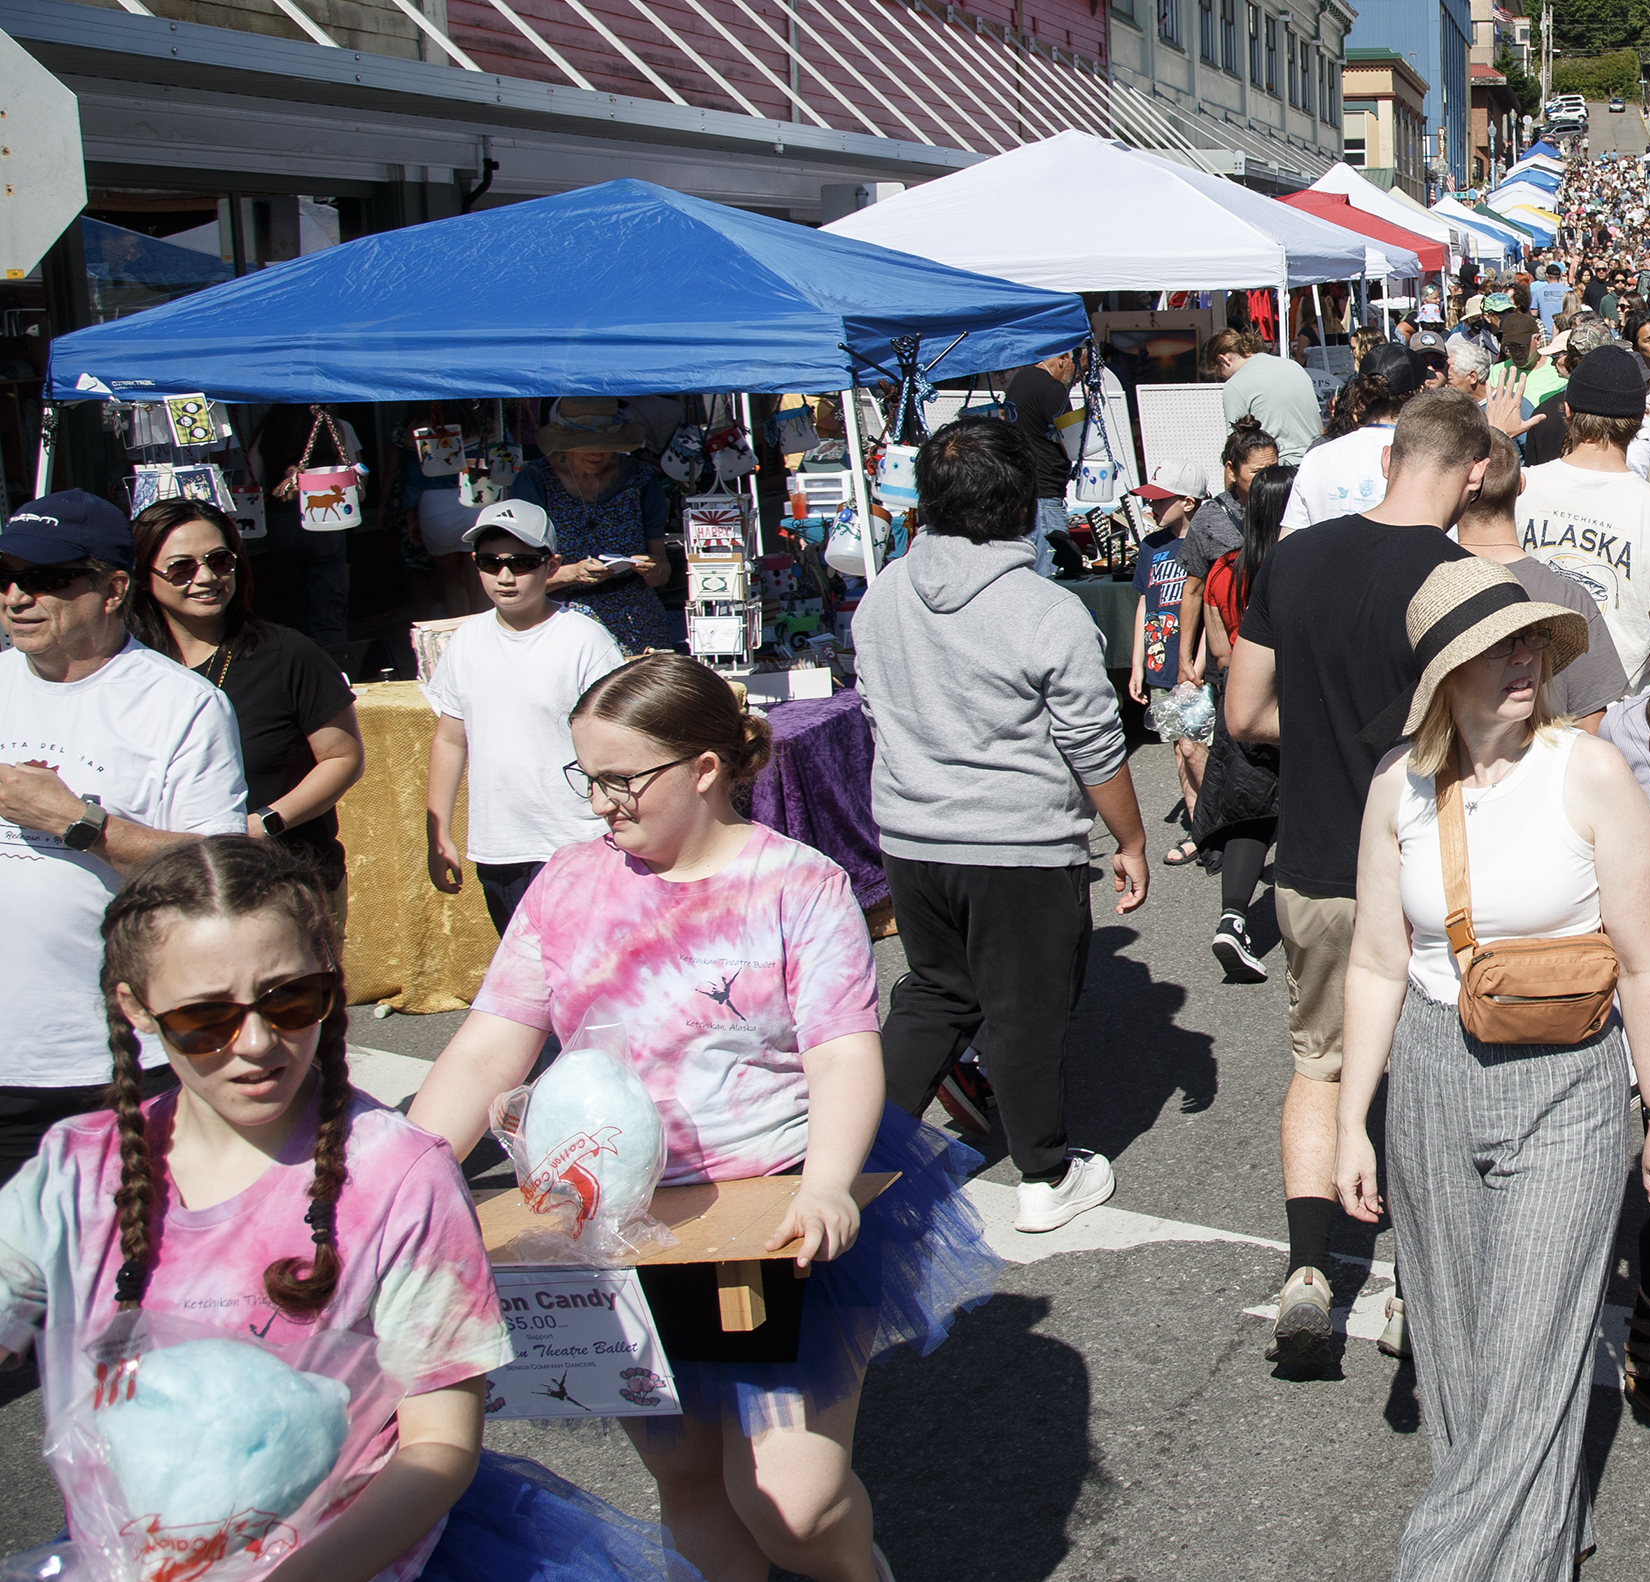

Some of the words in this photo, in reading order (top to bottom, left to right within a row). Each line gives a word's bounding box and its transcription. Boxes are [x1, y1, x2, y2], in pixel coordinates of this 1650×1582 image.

[1552, 509, 1613, 530] KETCHIKAN
[697, 526, 732, 539] HAPPY
[1152, 550, 1170, 563] 92
[1523, 518, 1632, 582] ALASKA
[40, 742, 65, 754] DEL
[680, 953, 717, 966] Ketchikan
[719, 958, 752, 968] Theatre
[753, 960, 777, 969] Ballet
[550, 1137, 586, 1169] Cotton
[183, 1298, 239, 1310] Ketchikan
[535, 1288, 617, 1312] Candy
[507, 1314, 557, 1332] $5.00
[525, 1333, 555, 1342] Support
[533, 1344, 589, 1359] Theatre
[593, 1341, 639, 1356] Ballet
[565, 1361, 597, 1369] DANCERS
